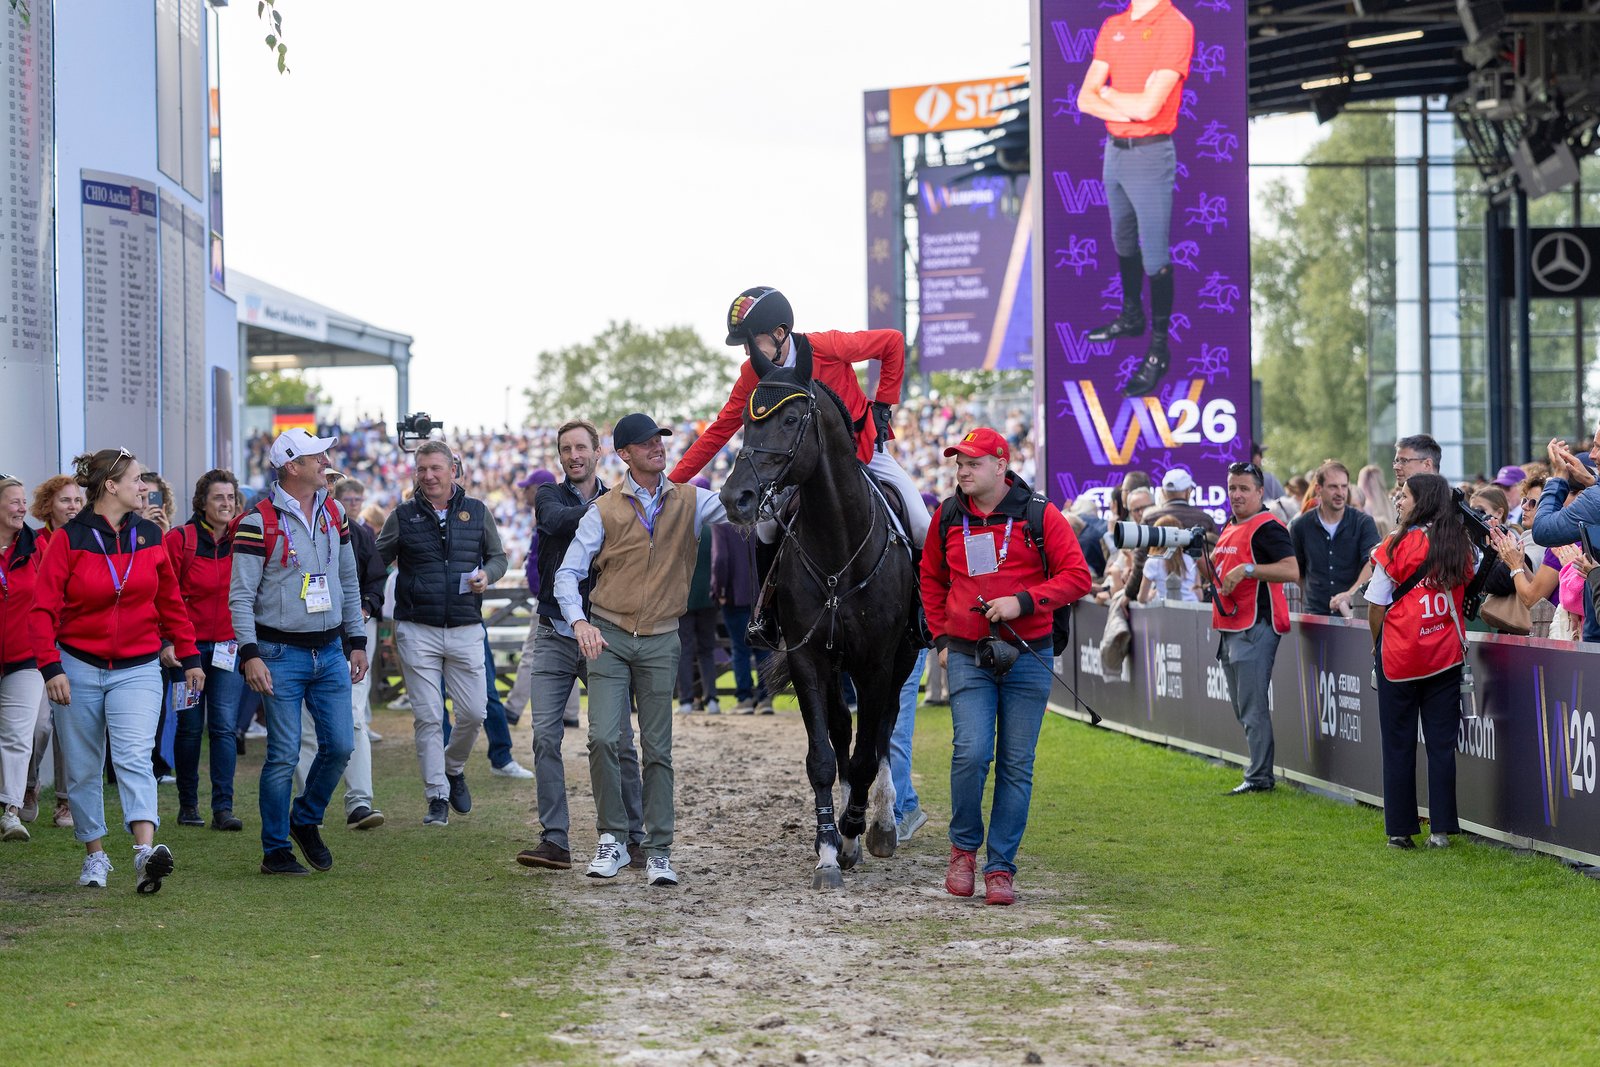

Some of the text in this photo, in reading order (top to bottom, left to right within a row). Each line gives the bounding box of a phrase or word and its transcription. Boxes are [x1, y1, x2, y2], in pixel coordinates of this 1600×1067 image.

[955, 82, 1017, 120] STA
[85, 184, 107, 202] CHIO
[1168, 398, 1237, 443] 26
[1419, 593, 1449, 619] 10
[1320, 670, 1337, 737] 26
[1340, 711, 1362, 743] AACHEN
[1570, 709, 1597, 794] 26
